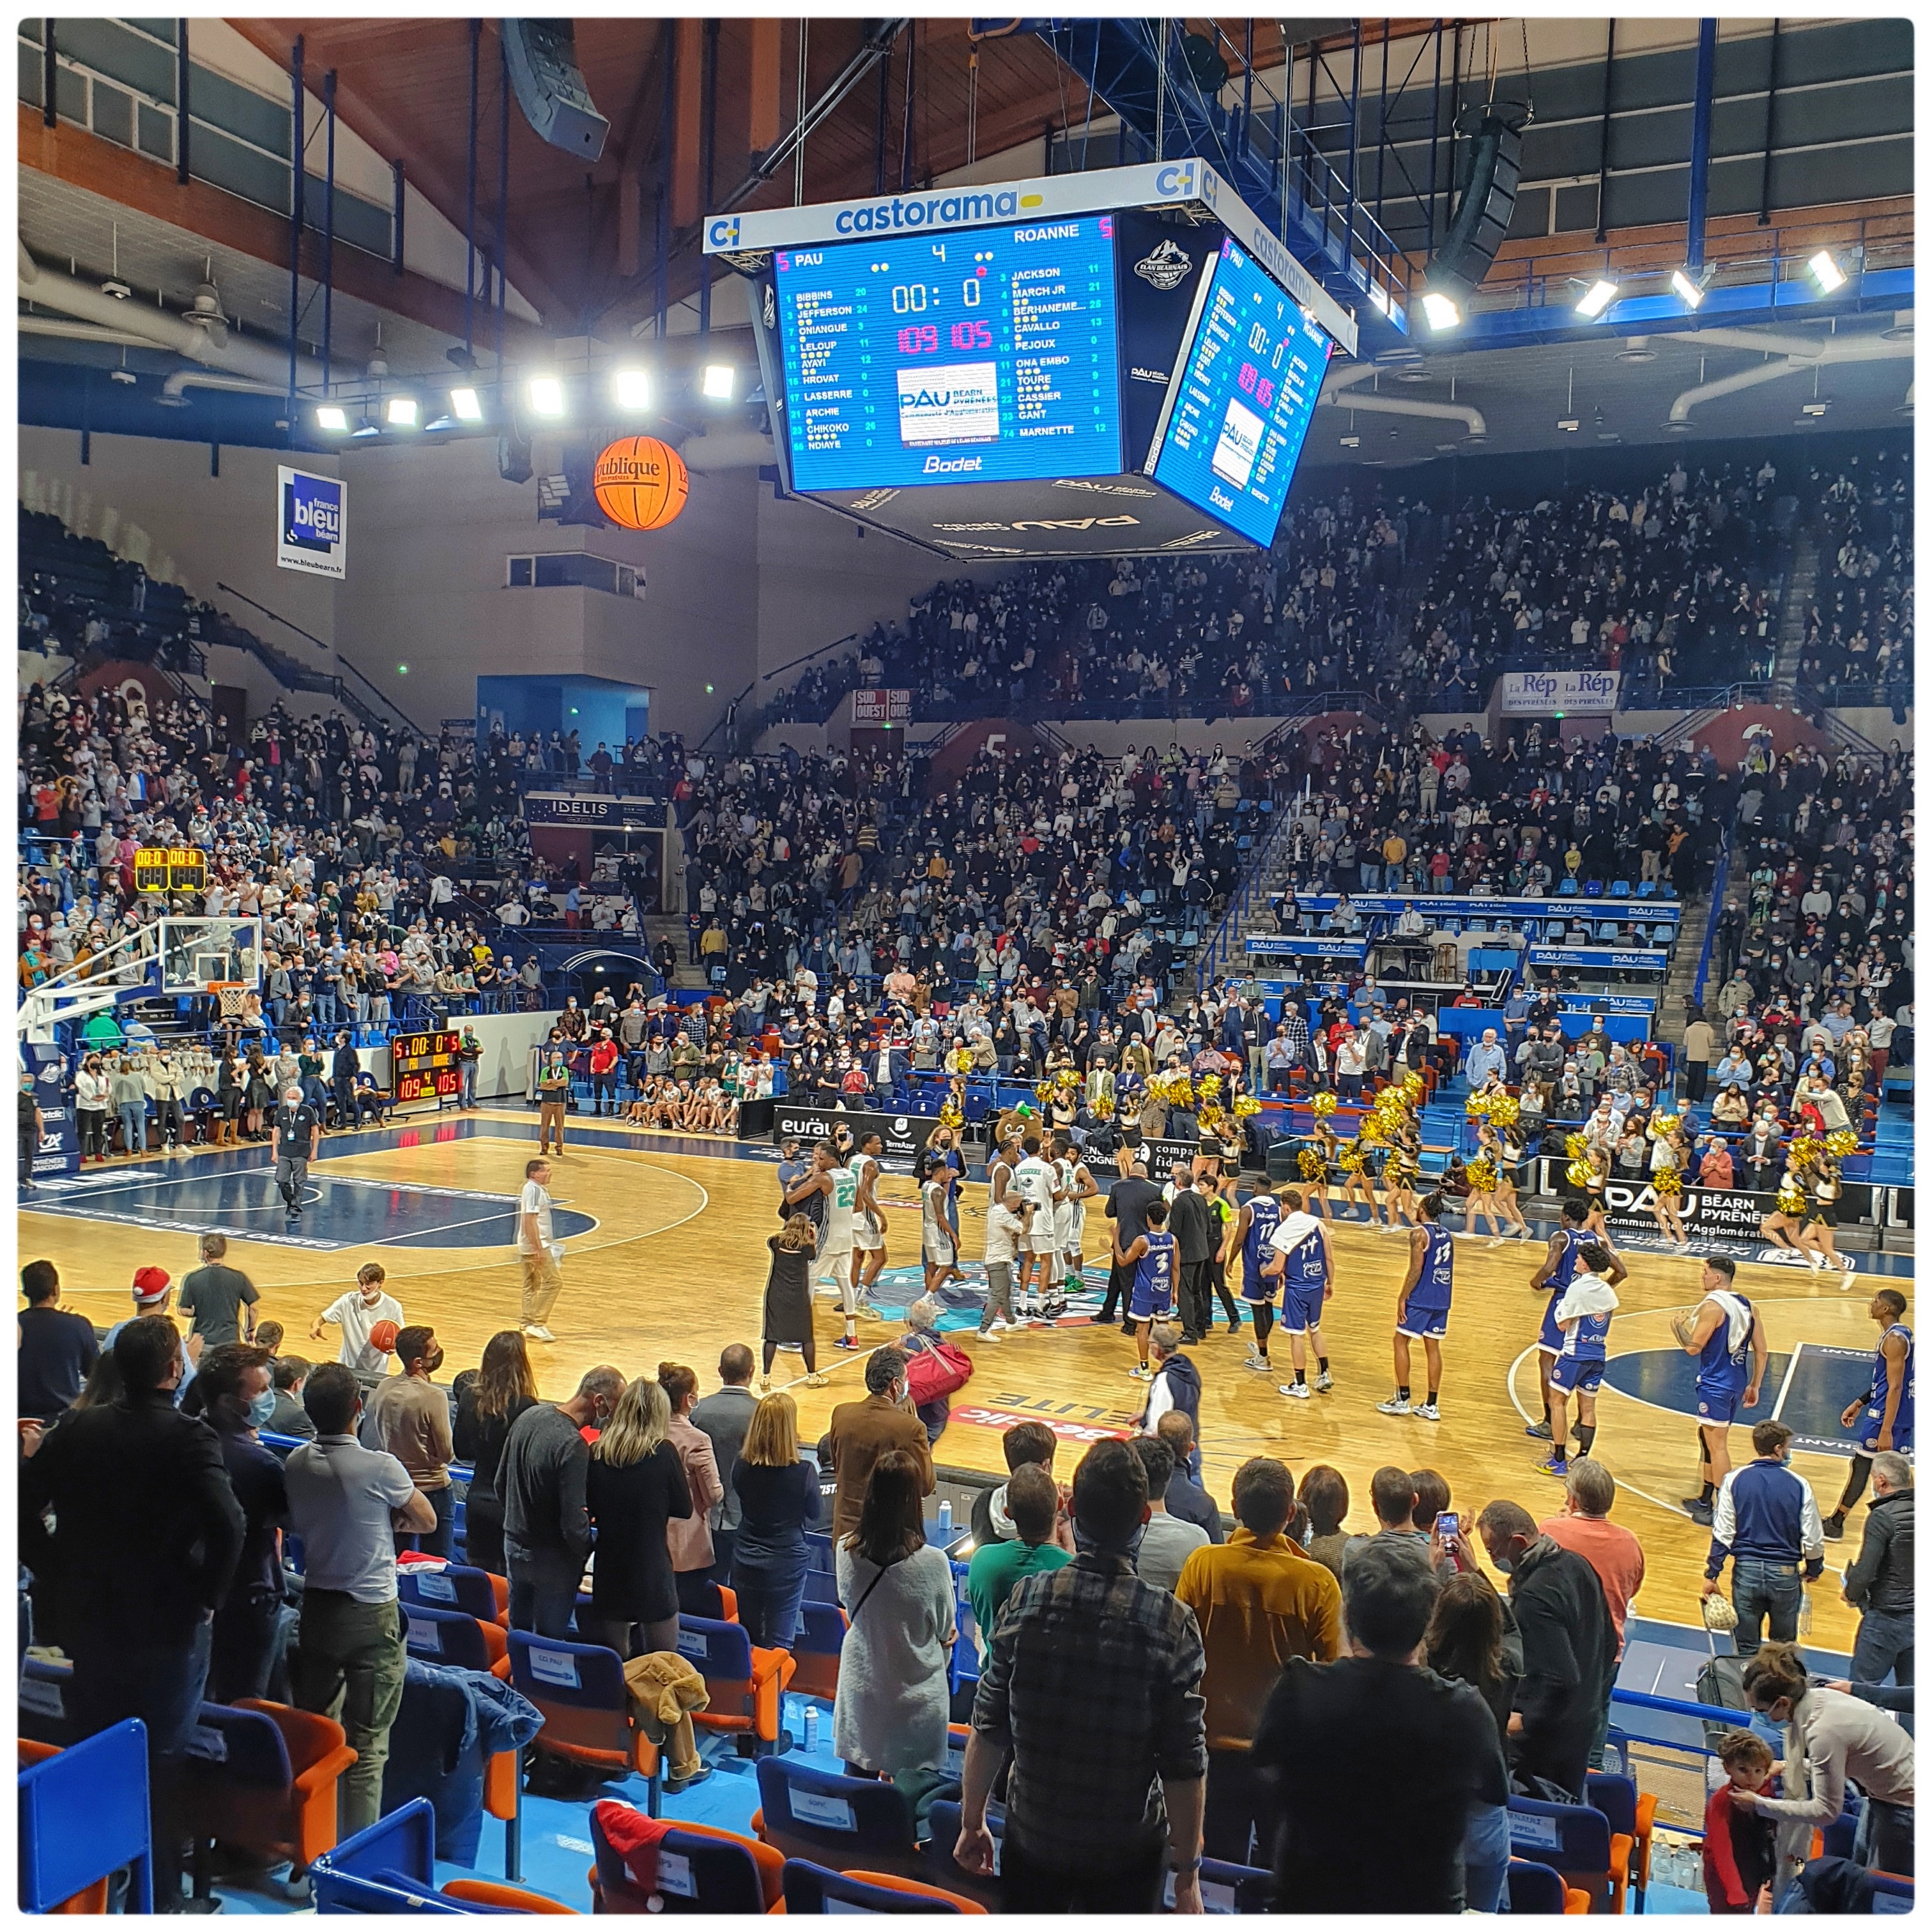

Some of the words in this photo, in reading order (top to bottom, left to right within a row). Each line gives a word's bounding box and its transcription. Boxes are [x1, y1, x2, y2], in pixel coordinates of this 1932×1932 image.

[835, 190, 1018, 234] castorama
[1014, 224, 1080, 243] ROANNE
[1099, 218, 1114, 239] 5
[932, 244, 946, 263] 4
[1229, 249, 1244, 268] PAU
[778, 252, 790, 272] 5
[795, 253, 823, 267] PAU
[1254, 227, 1312, 303] castorama
[1000, 273, 1006, 282] 3
[1011, 268, 1061, 281] JACKSON
[1088, 264, 1099, 273] 11
[786, 295, 792, 303] 1
[796, 290, 833, 302] BIBBINS
[855, 288, 866, 297] 20
[1001, 291, 1008, 300] 4
[1013, 287, 1050, 298] MARCH
[1052, 285, 1066, 295] JR
[1089, 282, 1100, 291] 21
[797, 305, 852, 319] JEFFERSON
[788, 328, 794, 337] 7
[799, 323, 848, 335] ONIANGUE
[1015, 321, 1060, 333] CAVALLO
[1091, 318, 1102, 326] 13
[898, 326, 938, 354] 109
[951, 320, 992, 349] 105
[800, 341, 837, 352] LELOUP
[859, 339, 869, 348] 11
[999, 343, 1010, 352] 10
[1015, 339, 1055, 351] PEJOUX
[1091, 335, 1098, 344] 0
[788, 361, 797, 369] 11
[801, 358, 826, 369] AYAYI
[861, 355, 871, 364] 12
[1000, 361, 1010, 369] 11
[1016, 358, 1038, 368] ONA
[1040, 356, 1070, 366] EMBO
[1092, 354, 1098, 362] 2
[803, 374, 839, 385] HROVAT
[1000, 378, 1011, 387] 21
[1017, 374, 1051, 386] TOURE
[1092, 371, 1098, 380] 9
[1131, 368, 1152, 378] PAU
[790, 394, 800, 402] 17
[804, 390, 853, 401] LASSERRE
[899, 389, 951, 409] PAU
[1001, 395, 1013, 404] 22
[1018, 392, 1061, 402] CASSIER
[791, 410, 801, 418] 21
[806, 407, 839, 418] ARCHIE
[1018, 410, 1046, 420] GANT
[807, 423, 849, 434] CHIKOKO
[1003, 430, 1015, 438] 74
[1020, 425, 1075, 437] MARNETTE
[1094, 424, 1106, 432] 12
[1221, 422, 1243, 445] PAU
[808, 440, 841, 450] NDIAYE
[1146, 436, 1163, 473] Bodet
[923, 455, 983, 473] Bodet
[1055, 479, 1114, 491] PAU
[313, 497, 339, 512] france
[1209, 486, 1234, 512] Bodet
[295, 498, 339, 532] bleu
[1011, 515, 1141, 530] PAU
[316, 528, 338, 542] béarn
[281, 556, 342, 574] www.bleubearn.fr
[1509, 684, 1520, 693] La
[1522, 674, 1558, 698] Rép
[1565, 684, 1575, 692] La
[1578, 673, 1614, 696] Rép
[857, 691, 876, 704] SUD
[890, 690, 910, 703] SUD
[857, 704, 885, 717] OUEST
[553, 801, 608, 815] IDELIS
[1548, 905, 1572, 913] PAU
[1629, 907, 1653, 916] PAU
[1319, 944, 1341, 952] PAU
[1537, 952, 1561, 960] PAU
[1613, 954, 1638, 963] PAU
[396, 1042, 402, 1058] 5
[452, 1036, 457, 1051] 5
[401, 1079, 420, 1098] 109
[424, 1072, 431, 1085] 4
[438, 1073, 456, 1092] 105
[885, 1140, 916, 1149] TerreAzur
[1156, 1145, 1198, 1158] compa
[836, 1185, 855, 1208] 23
[1701, 1194, 1756, 1210] BÉARN
[1701, 1209, 1770, 1224] PYRÉNÉE
[162, 1222, 213, 1230] PAU
[1259, 1222, 1275, 1241] 11
[246, 1233, 339, 1247] CASINO
[1300, 1235, 1319, 1261] 74
[1155, 1252, 1169, 1274] 3
